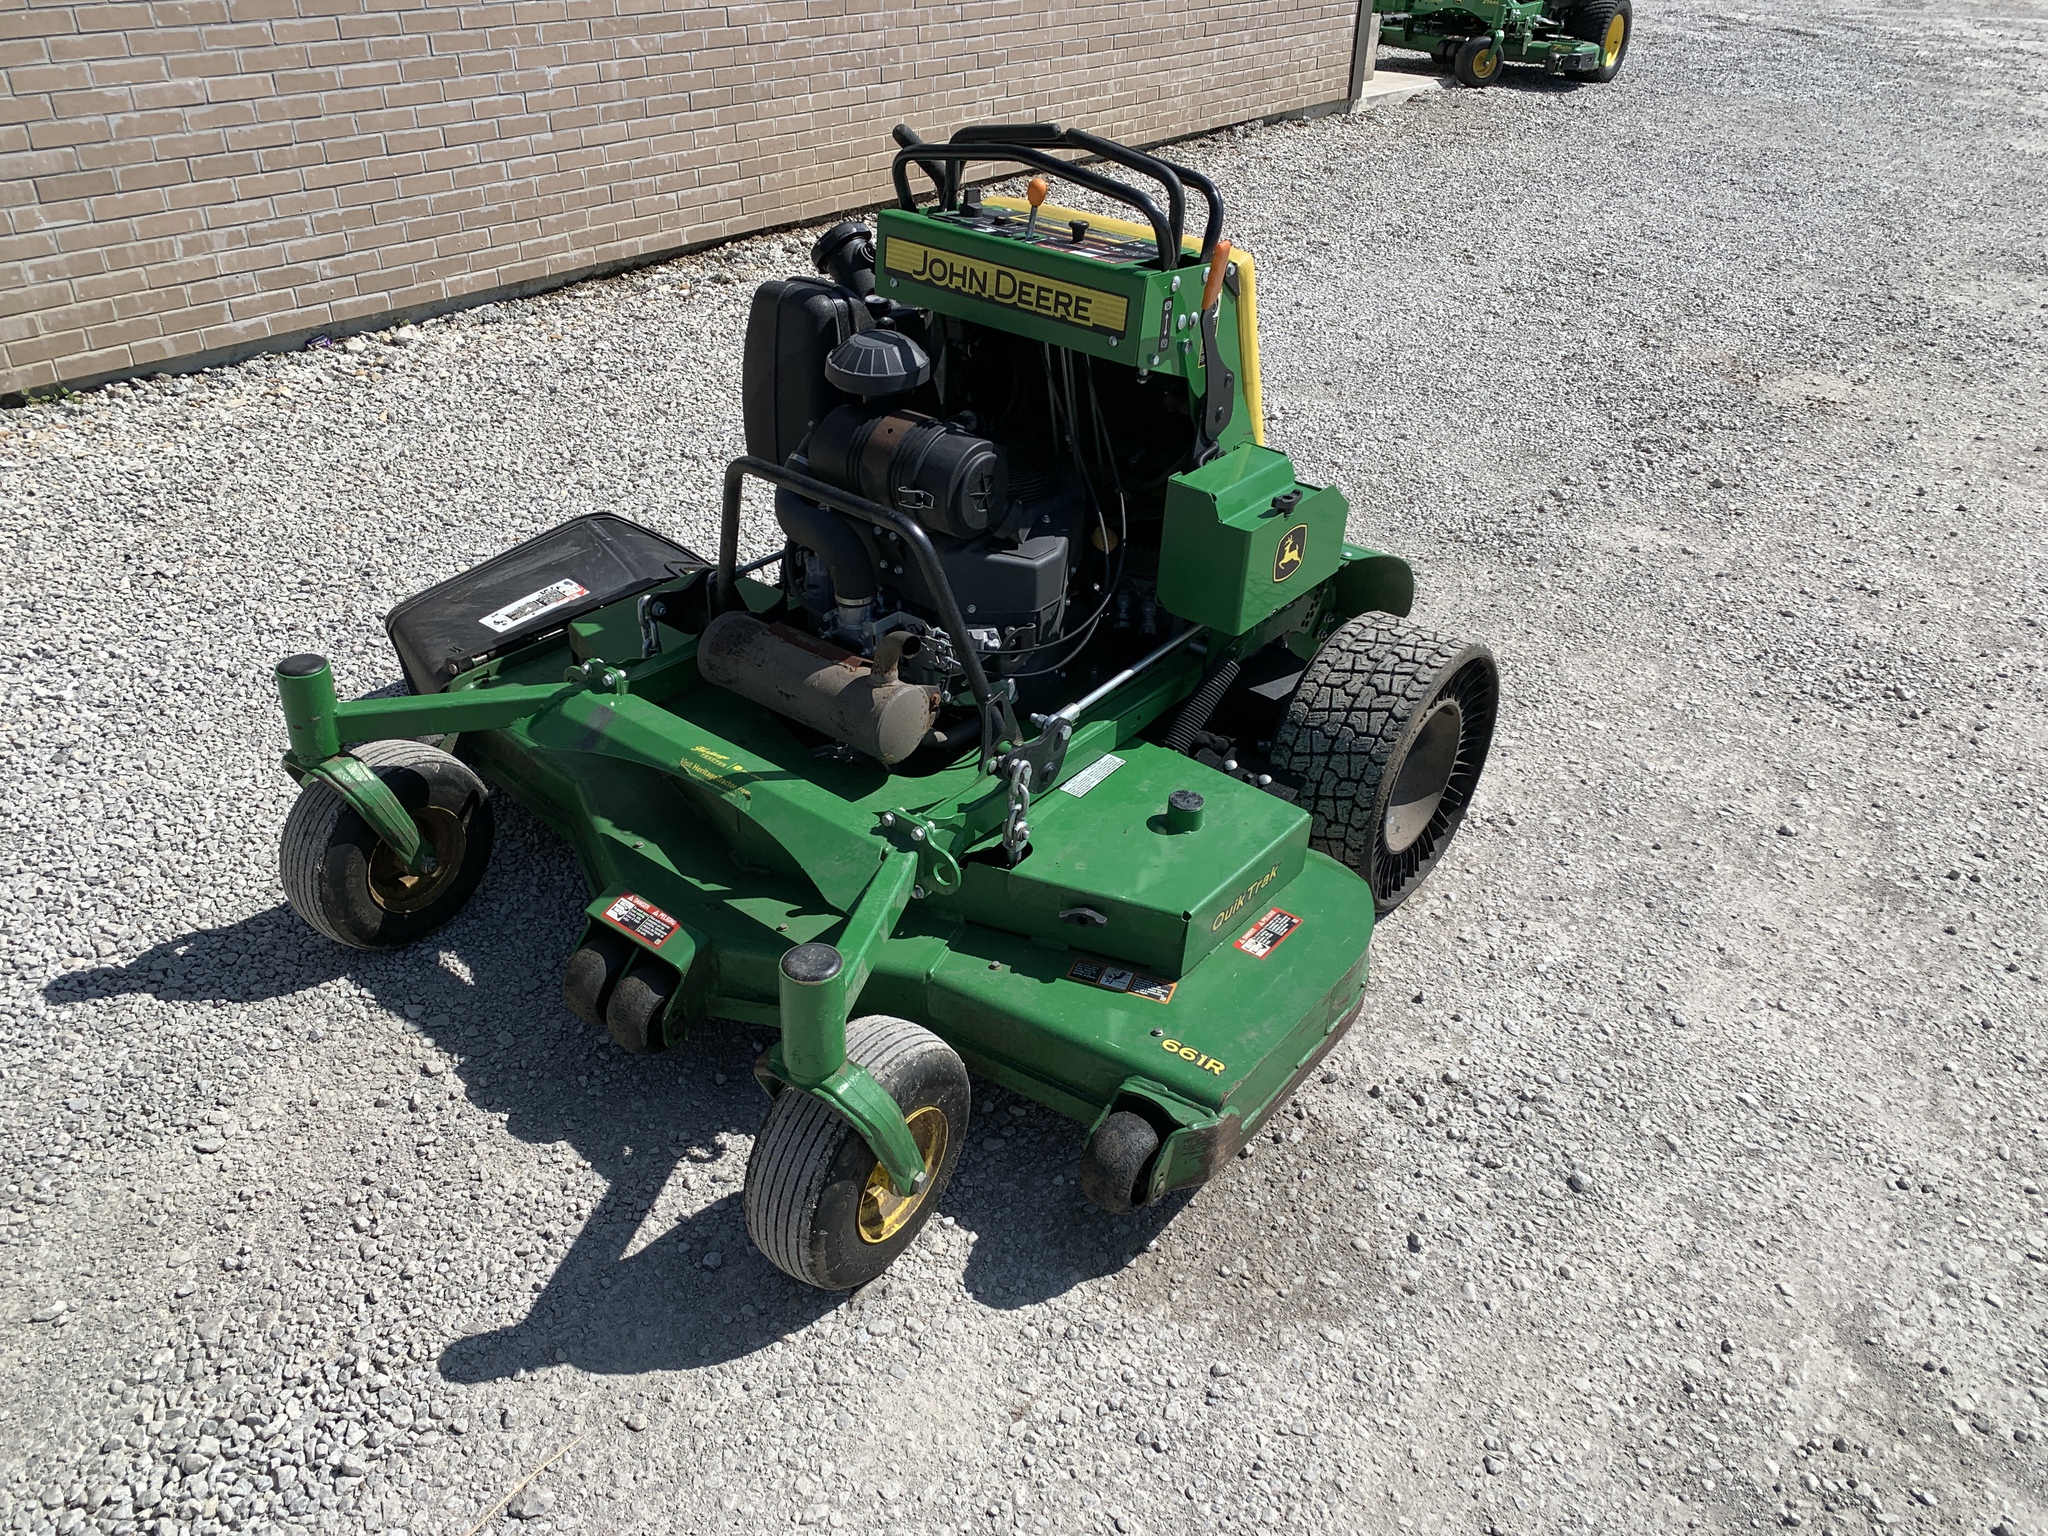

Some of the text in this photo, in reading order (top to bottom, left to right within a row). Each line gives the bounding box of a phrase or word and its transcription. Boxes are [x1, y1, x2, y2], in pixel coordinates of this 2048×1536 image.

[912, 250, 1093, 323] JOHN DEERE
[680, 757, 692, 768] Visit
[1161, 1039, 1226, 1076] 661R
